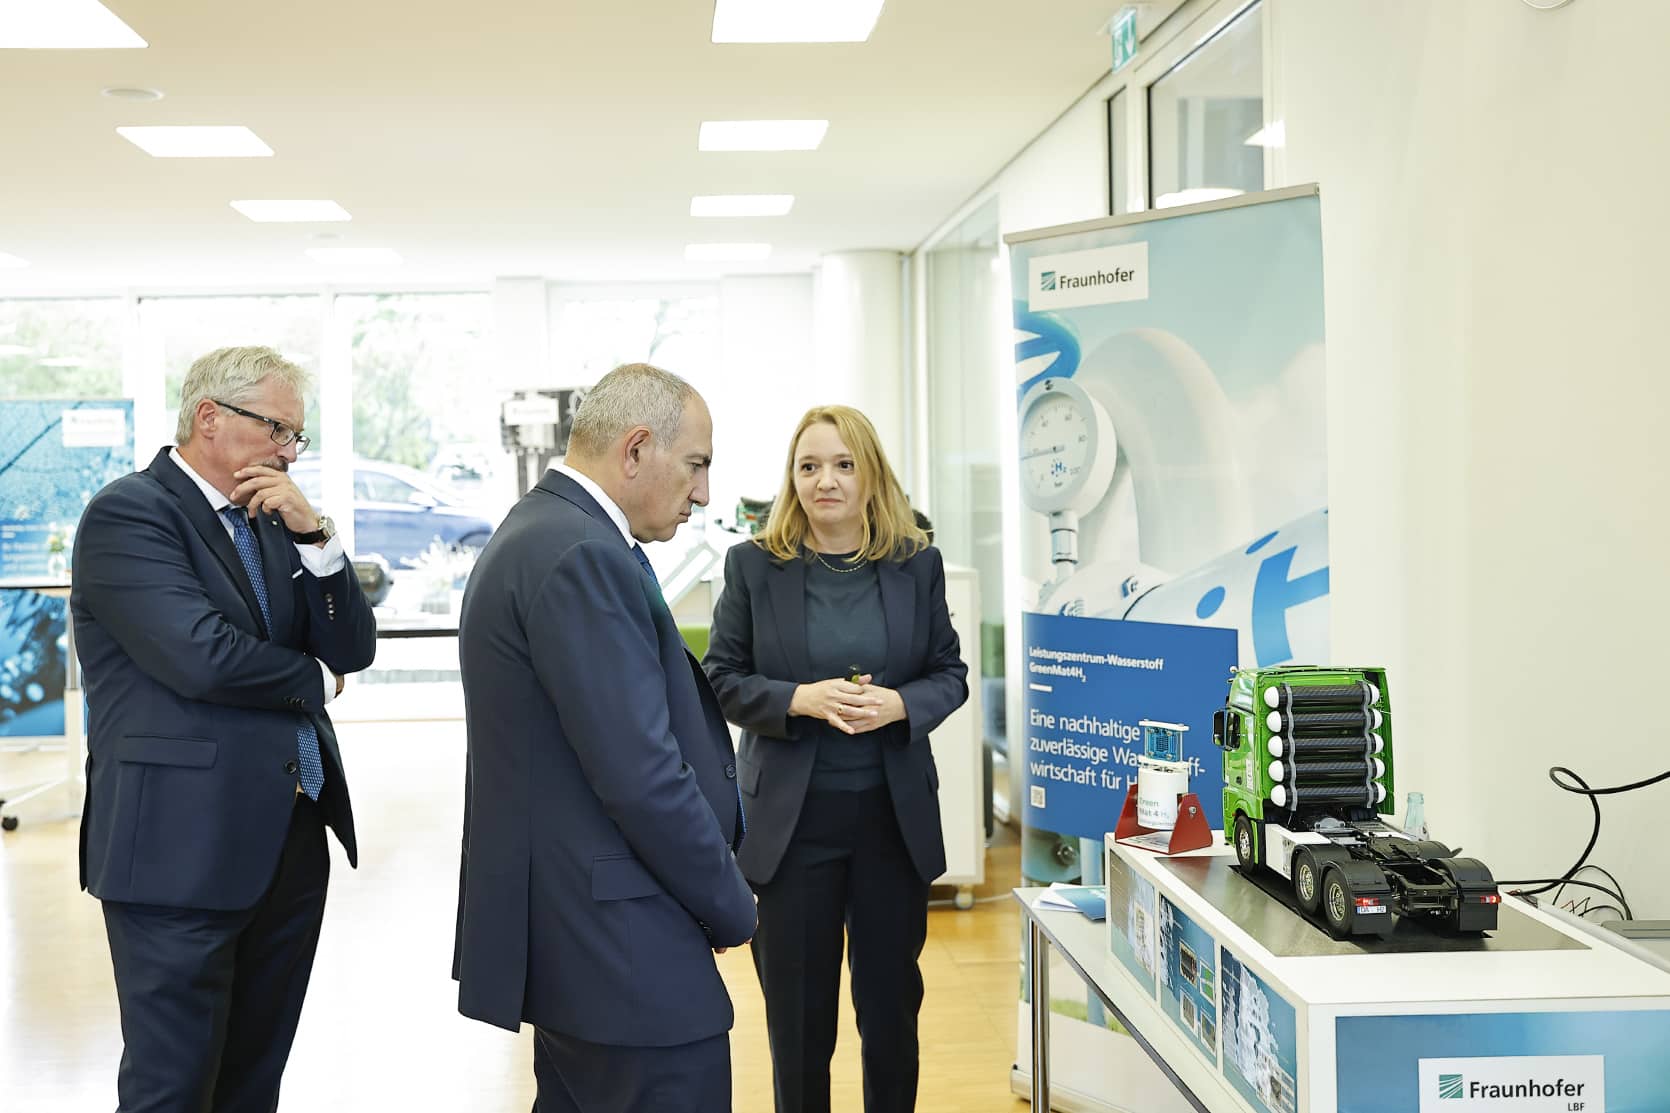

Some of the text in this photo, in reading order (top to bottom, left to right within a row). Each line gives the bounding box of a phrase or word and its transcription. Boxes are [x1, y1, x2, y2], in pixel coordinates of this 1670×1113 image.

[1059, 267, 1135, 289] Fraunhofer
[1029, 647, 1164, 670] Leistungszentrum-Wasserstoff
[1030, 708, 1140, 744] Eine nachhaltige
[1030, 737, 1108, 765] zuverlässige
[1030, 760, 1097, 786] wirtschaft
[1101, 769, 1122, 790] für
[1470, 1079, 1585, 1098] Fraunhofer
[1568, 1102, 1585, 1112] LBF
